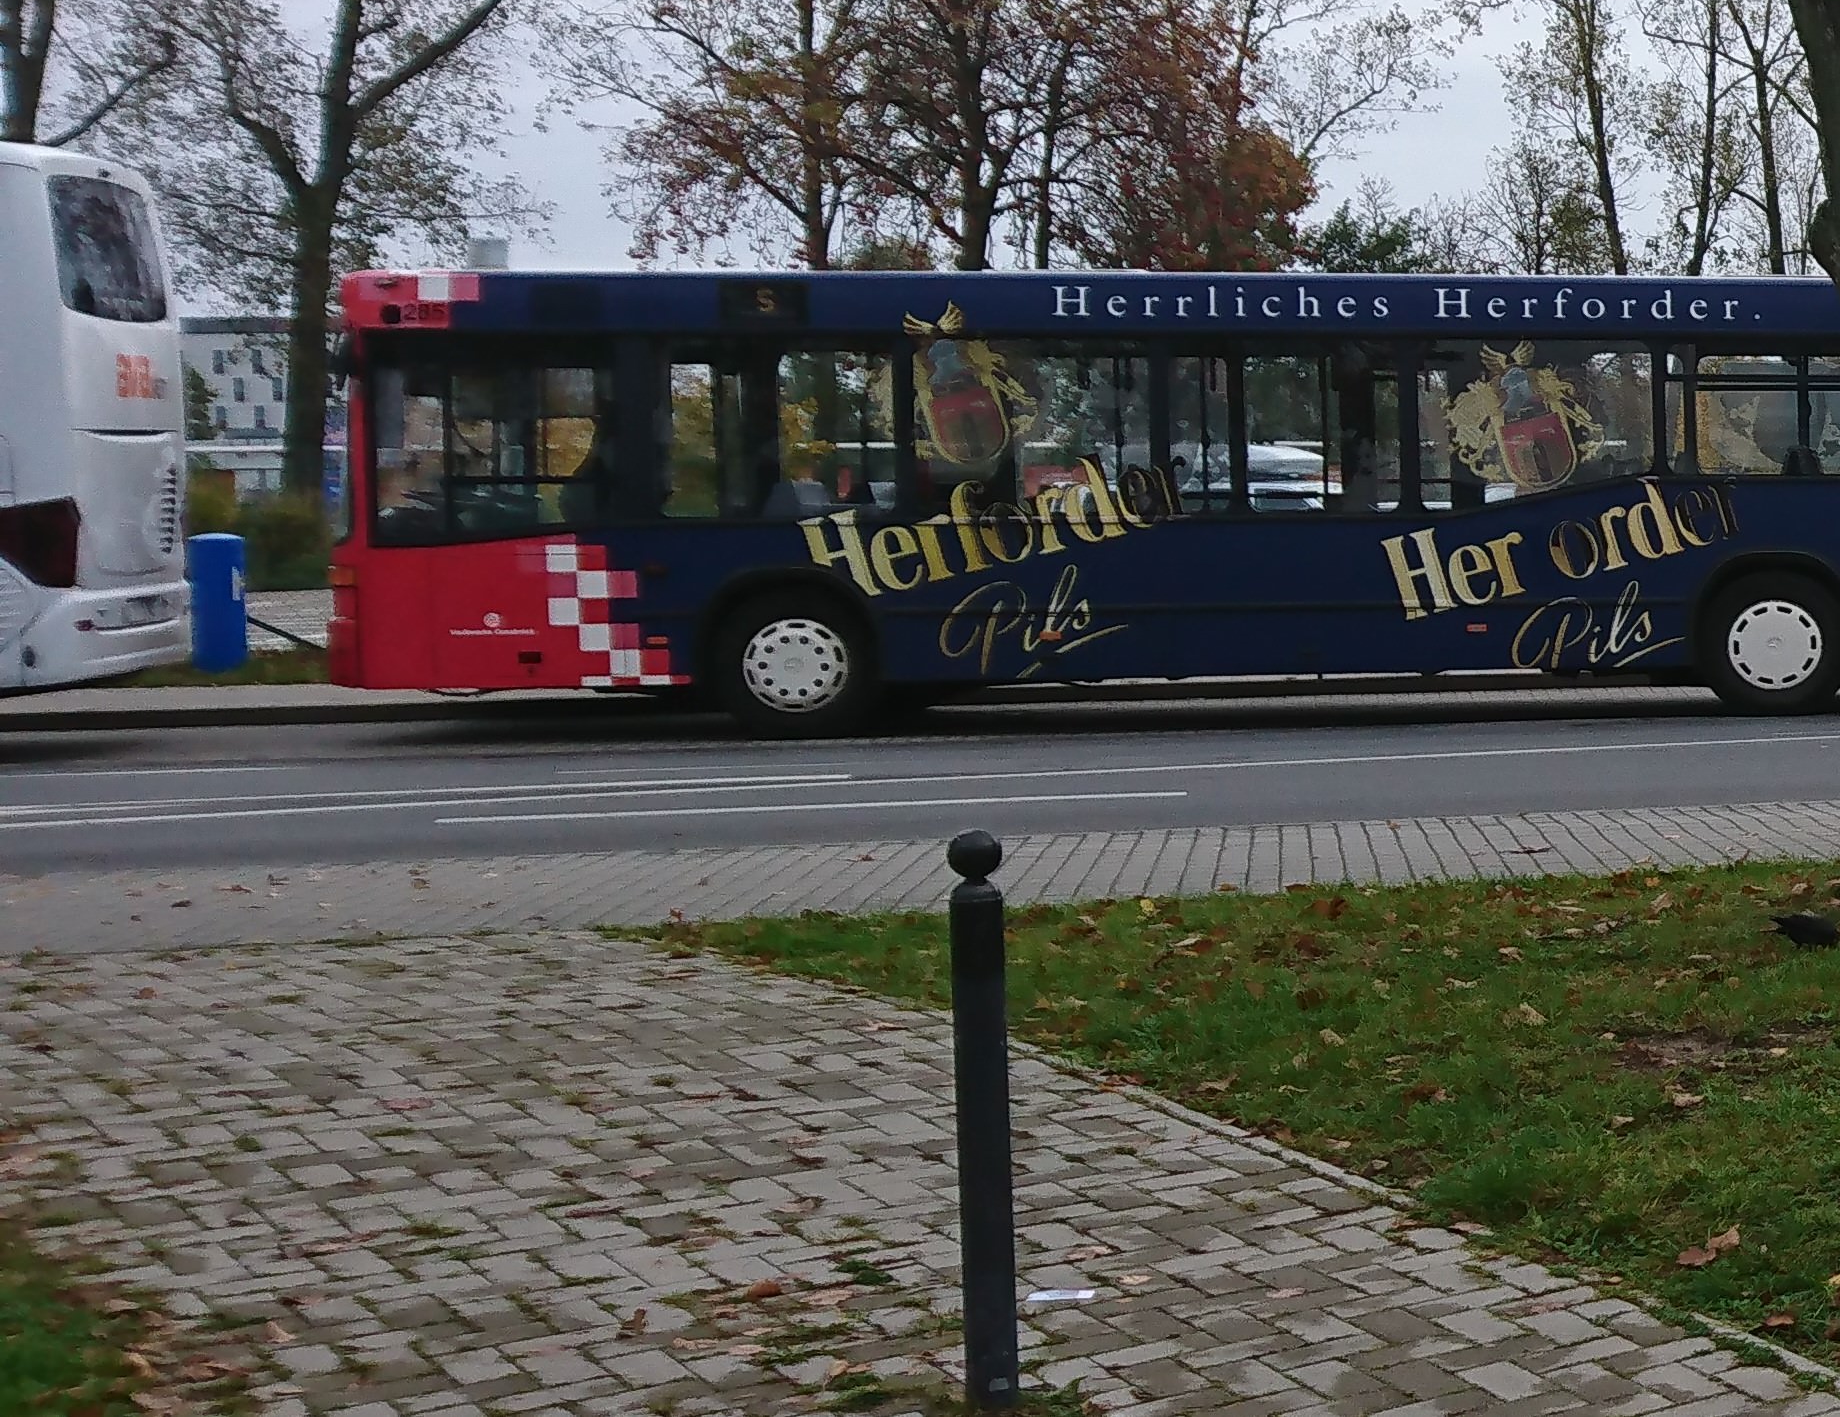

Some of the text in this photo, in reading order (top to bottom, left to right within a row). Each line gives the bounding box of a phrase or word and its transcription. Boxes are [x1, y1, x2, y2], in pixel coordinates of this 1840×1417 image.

[1051, 285, 1762, 321] Herrliches Herforder.
[796, 453, 1187, 597] Herforder
[940, 564, 1092, 675] Pils
[1511, 581, 1652, 670] Pils
